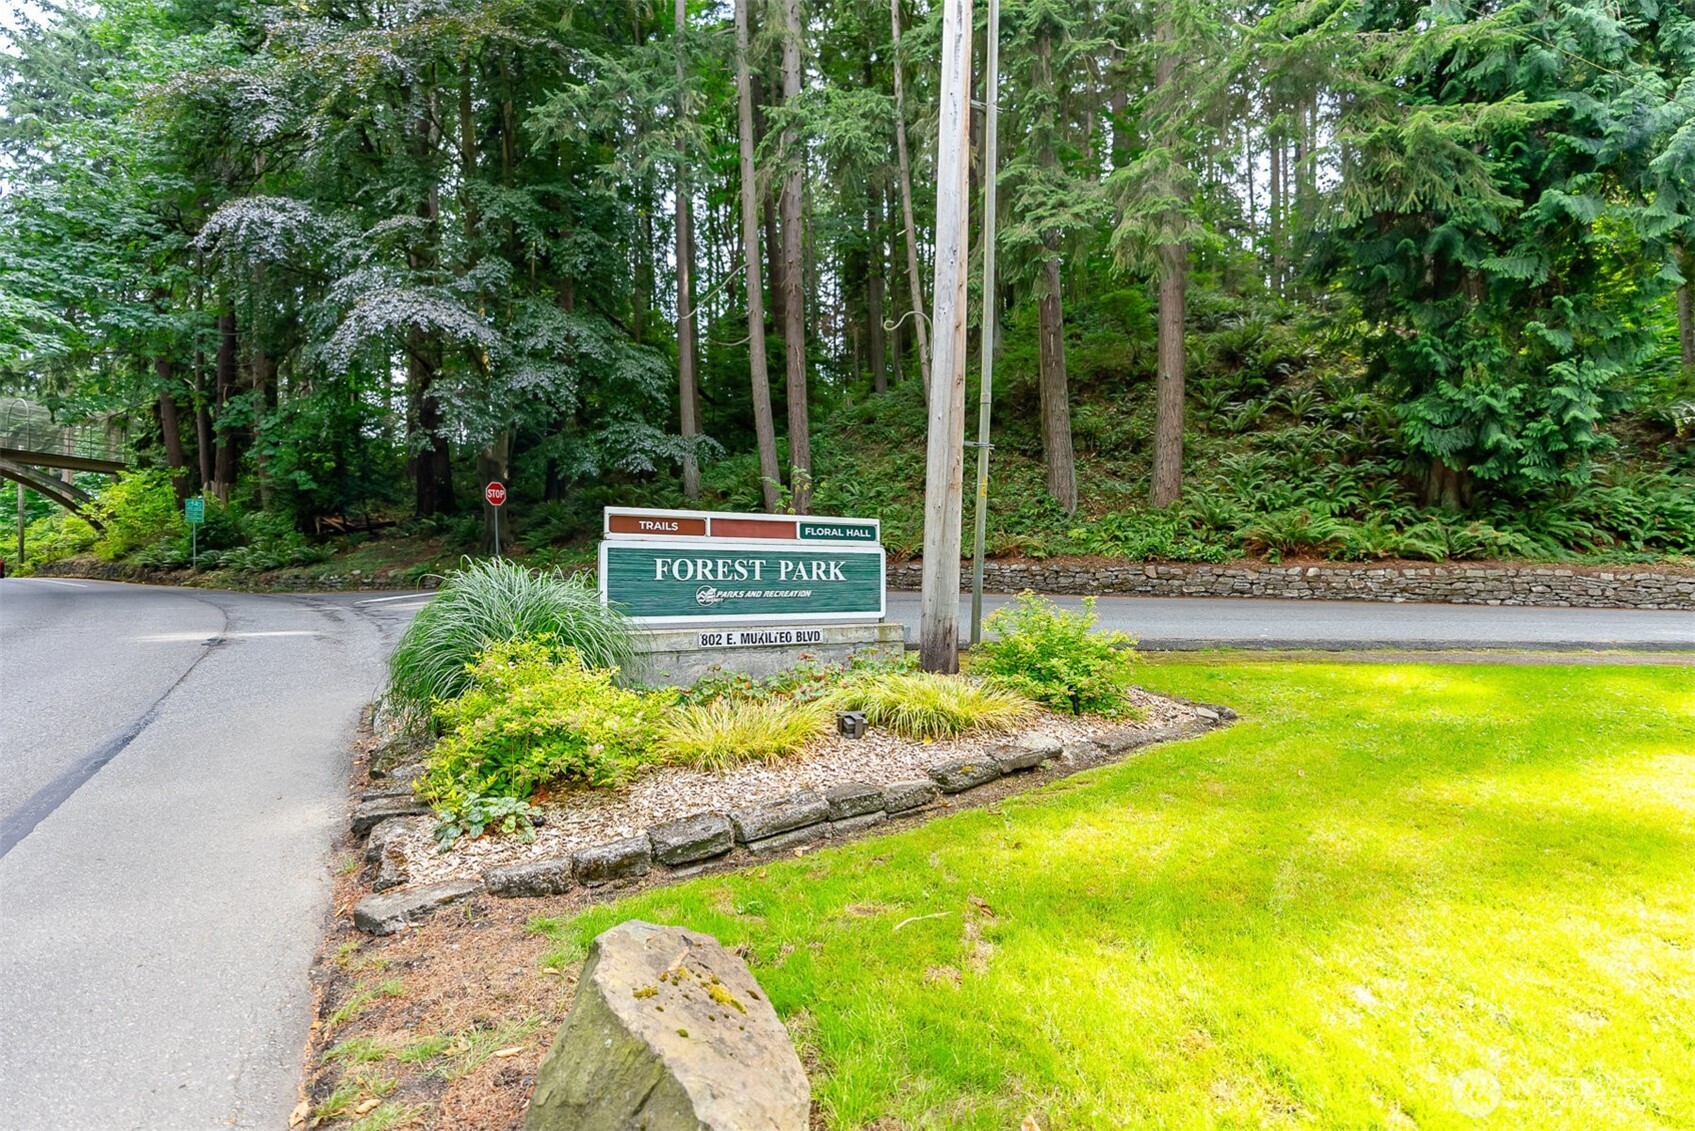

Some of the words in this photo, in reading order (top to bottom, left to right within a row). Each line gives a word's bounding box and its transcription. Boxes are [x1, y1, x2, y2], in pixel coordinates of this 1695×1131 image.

[487, 489, 505, 498] STOP
[639, 521, 679, 531] TRAILS
[805, 527, 844, 537] FLORAL
[846, 529, 871, 537] HALL
[654, 558, 767, 581] FOREST
[778, 560, 847, 581] PARK
[716, 590, 745, 598] PARKS
[744, 590, 763, 598] AND
[763, 590, 812, 598] RECREATION
[701, 634, 722, 646] 802
[726, 633, 737, 645] E.
[796, 631, 821, 642] BLVD
